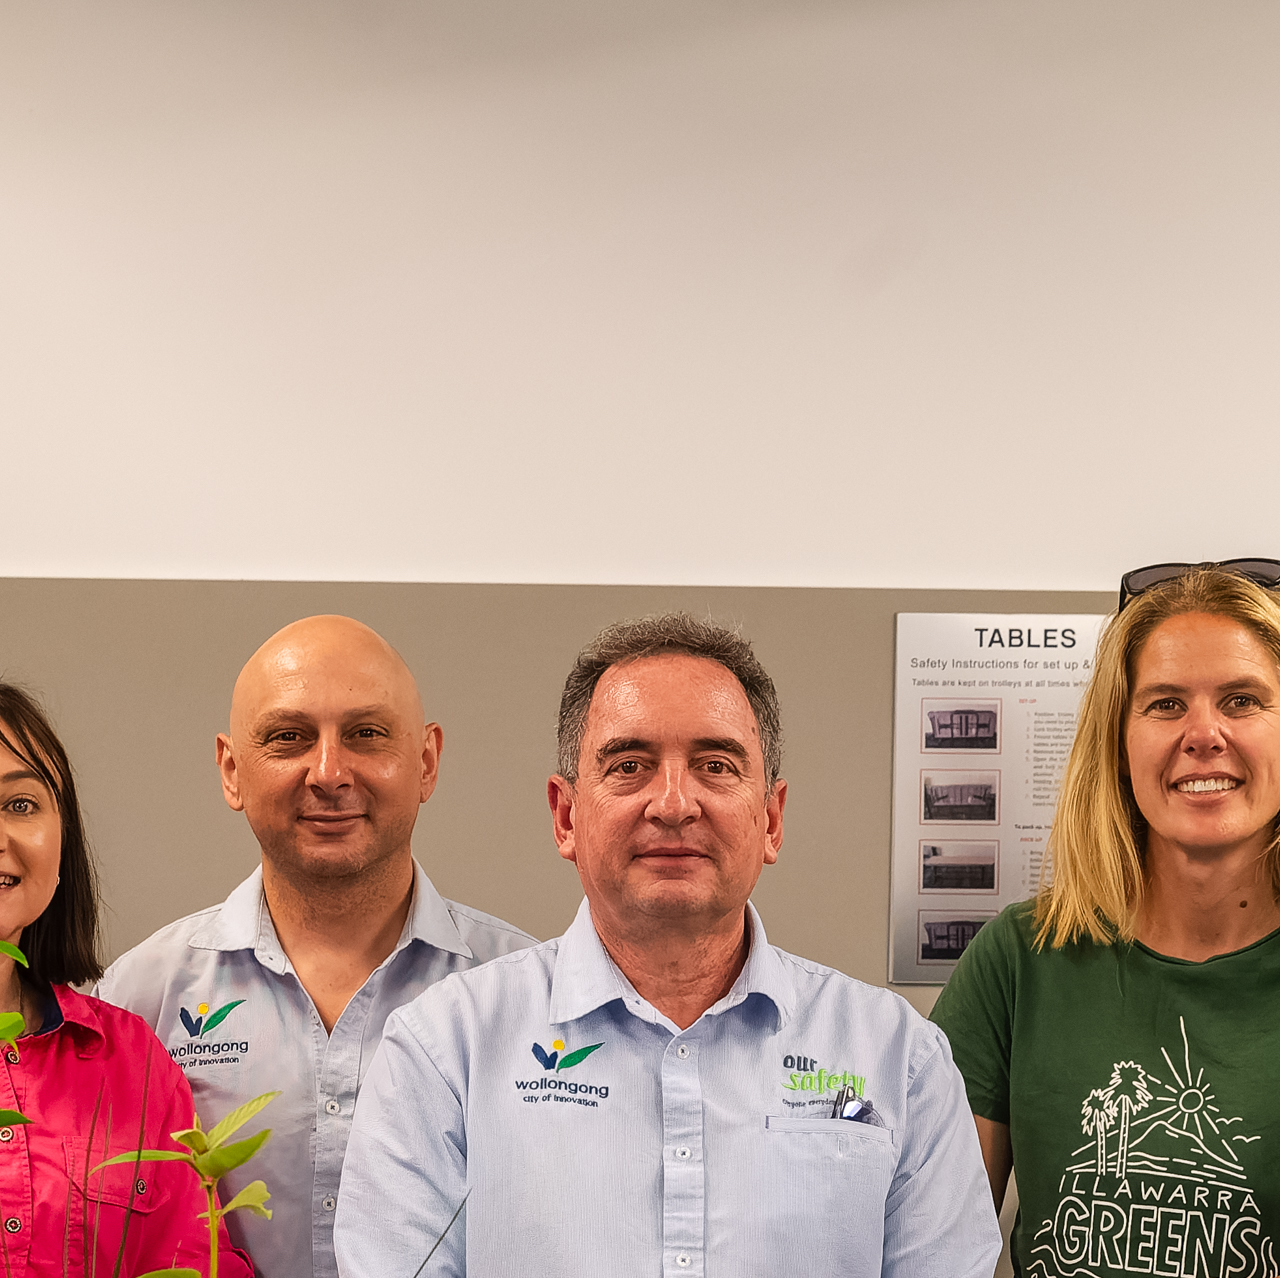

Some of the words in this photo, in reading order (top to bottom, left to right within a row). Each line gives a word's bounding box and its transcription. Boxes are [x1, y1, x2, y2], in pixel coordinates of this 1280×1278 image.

[974, 628, 1077, 649] TABLES
[910, 657, 948, 671] Safety
[952, 658, 1020, 670] Instructions
[1023, 658, 1039, 670] for
[1042, 659, 1060, 670] set
[1064, 661, 1079, 672] up
[1082, 660, 1091, 670] &
[912, 678, 939, 687] Tables
[957, 679, 976, 689] kept
[978, 680, 990, 688] on
[991, 678, 1022, 689] trolleys
[1024, 679, 1034, 688] at
[1035, 679, 1046, 688] all
[168, 1040, 250, 1059] wollongong
[188, 1059, 197, 1068] of
[782, 1054, 818, 1073] our
[514, 1077, 610, 1099] wollongong
[780, 1068, 866, 1098] safety
[522, 1094, 540, 1105] city
[541, 1092, 552, 1103] of
[1057, 1173, 1261, 1216] ILLAWARRA
